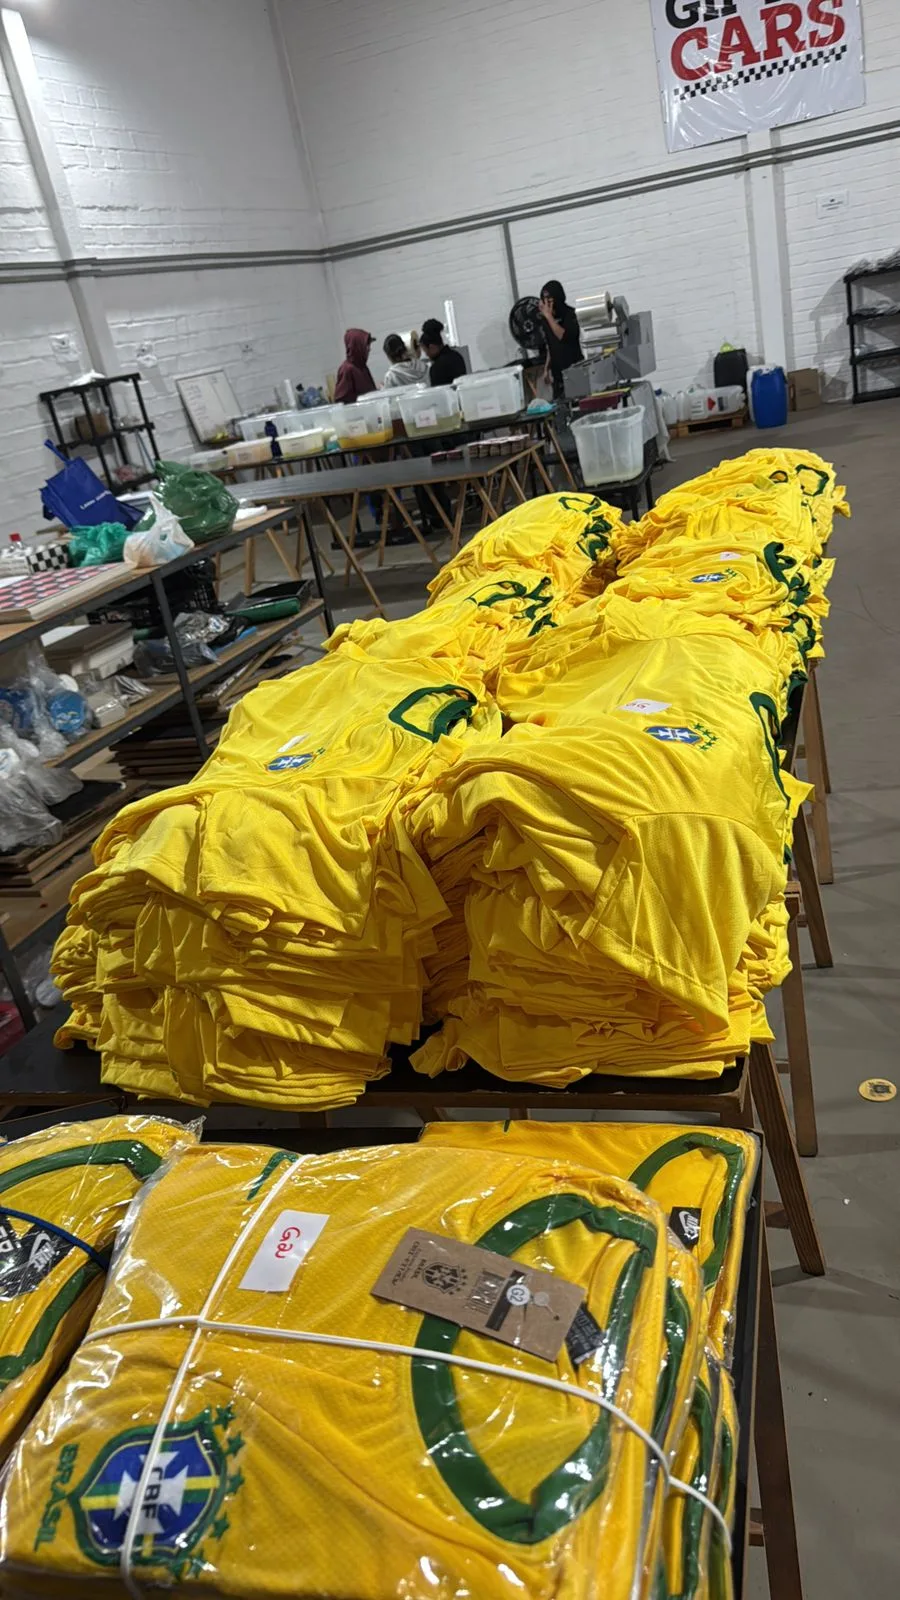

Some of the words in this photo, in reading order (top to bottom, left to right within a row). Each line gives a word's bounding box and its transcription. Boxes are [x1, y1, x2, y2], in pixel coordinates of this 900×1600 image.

[670, 0, 845, 81] CARS
[512, 1287, 525, 1303] G2
[34, 1443, 79, 1552] BRASIL
[141, 1467, 162, 1520] CBF
